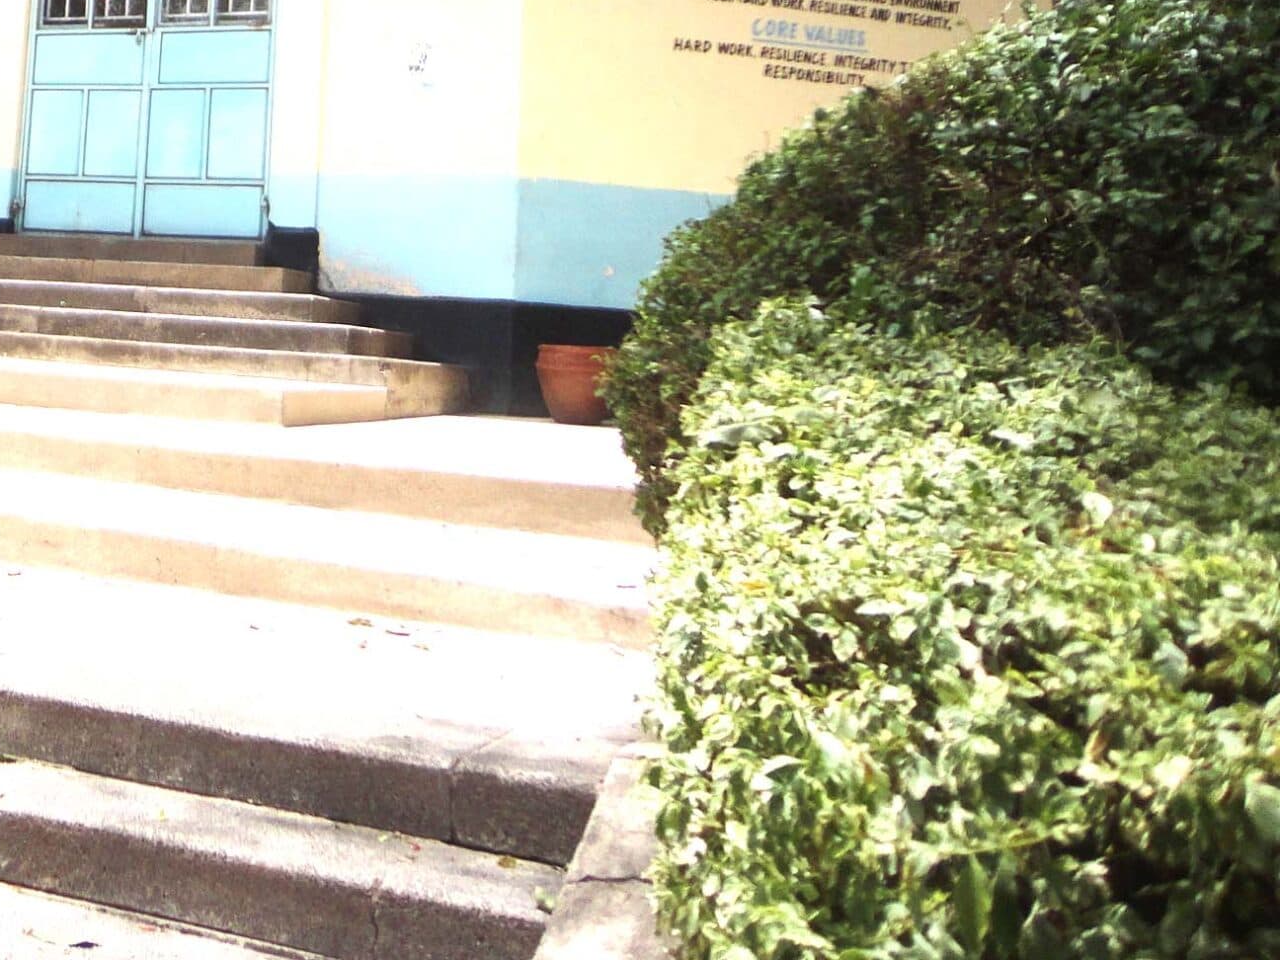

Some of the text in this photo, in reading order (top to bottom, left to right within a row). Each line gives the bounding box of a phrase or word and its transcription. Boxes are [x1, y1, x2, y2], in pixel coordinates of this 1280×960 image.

[809, 0, 868, 19] RESILIENCE
[870, 8, 891, 22] AND
[752, 18, 866, 47] CORE VALUES
[673, 38, 712, 53] HARD
[760, 46, 827, 66] RESILIENCE
[834, 54, 896, 74] INTEGRITY
